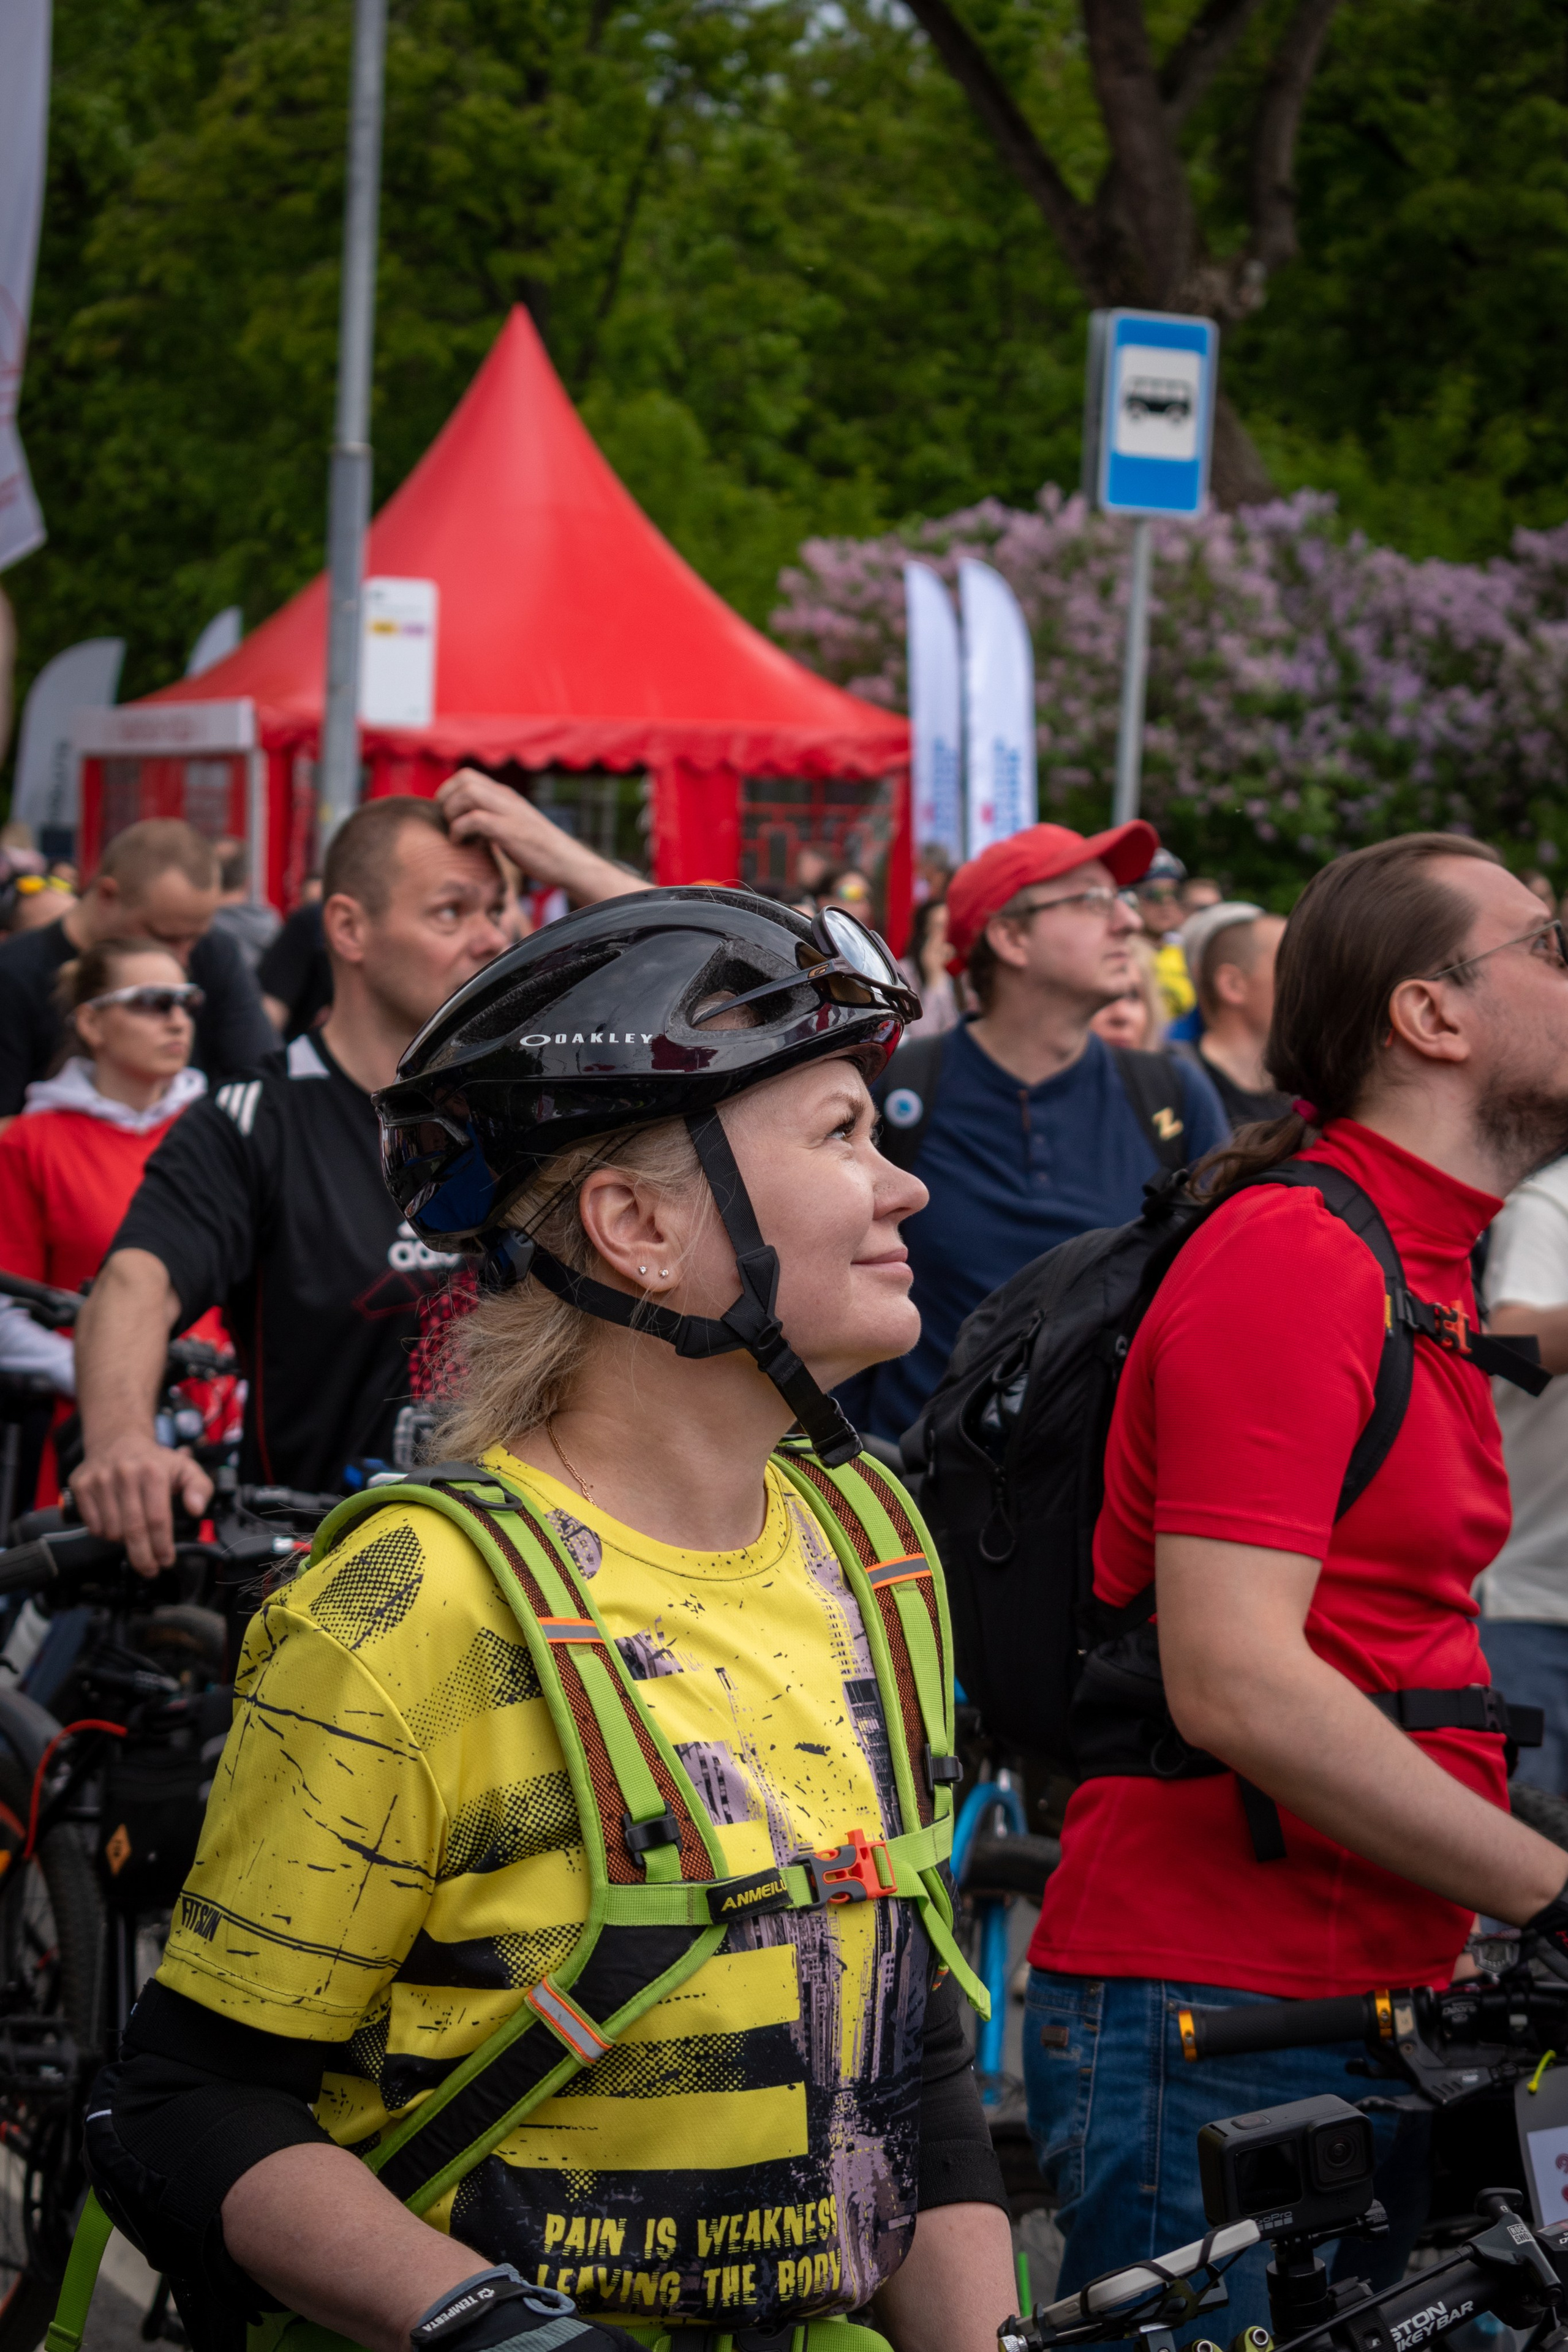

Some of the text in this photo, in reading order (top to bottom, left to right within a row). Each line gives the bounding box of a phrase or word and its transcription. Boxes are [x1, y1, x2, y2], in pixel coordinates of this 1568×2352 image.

[555, 1033, 653, 1044] OAKLEY
[1152, 1106, 1183, 1140] Z
[544, 2193, 838, 2260] PAIN IS WEAKNESS
[1254, 2211, 1292, 2225] GoPro
[1515, 2233, 1532, 2242] SHO
[537, 2248, 841, 2307] LEAVING THE BODY
[421, 2295, 478, 2332] TEMPESTA
